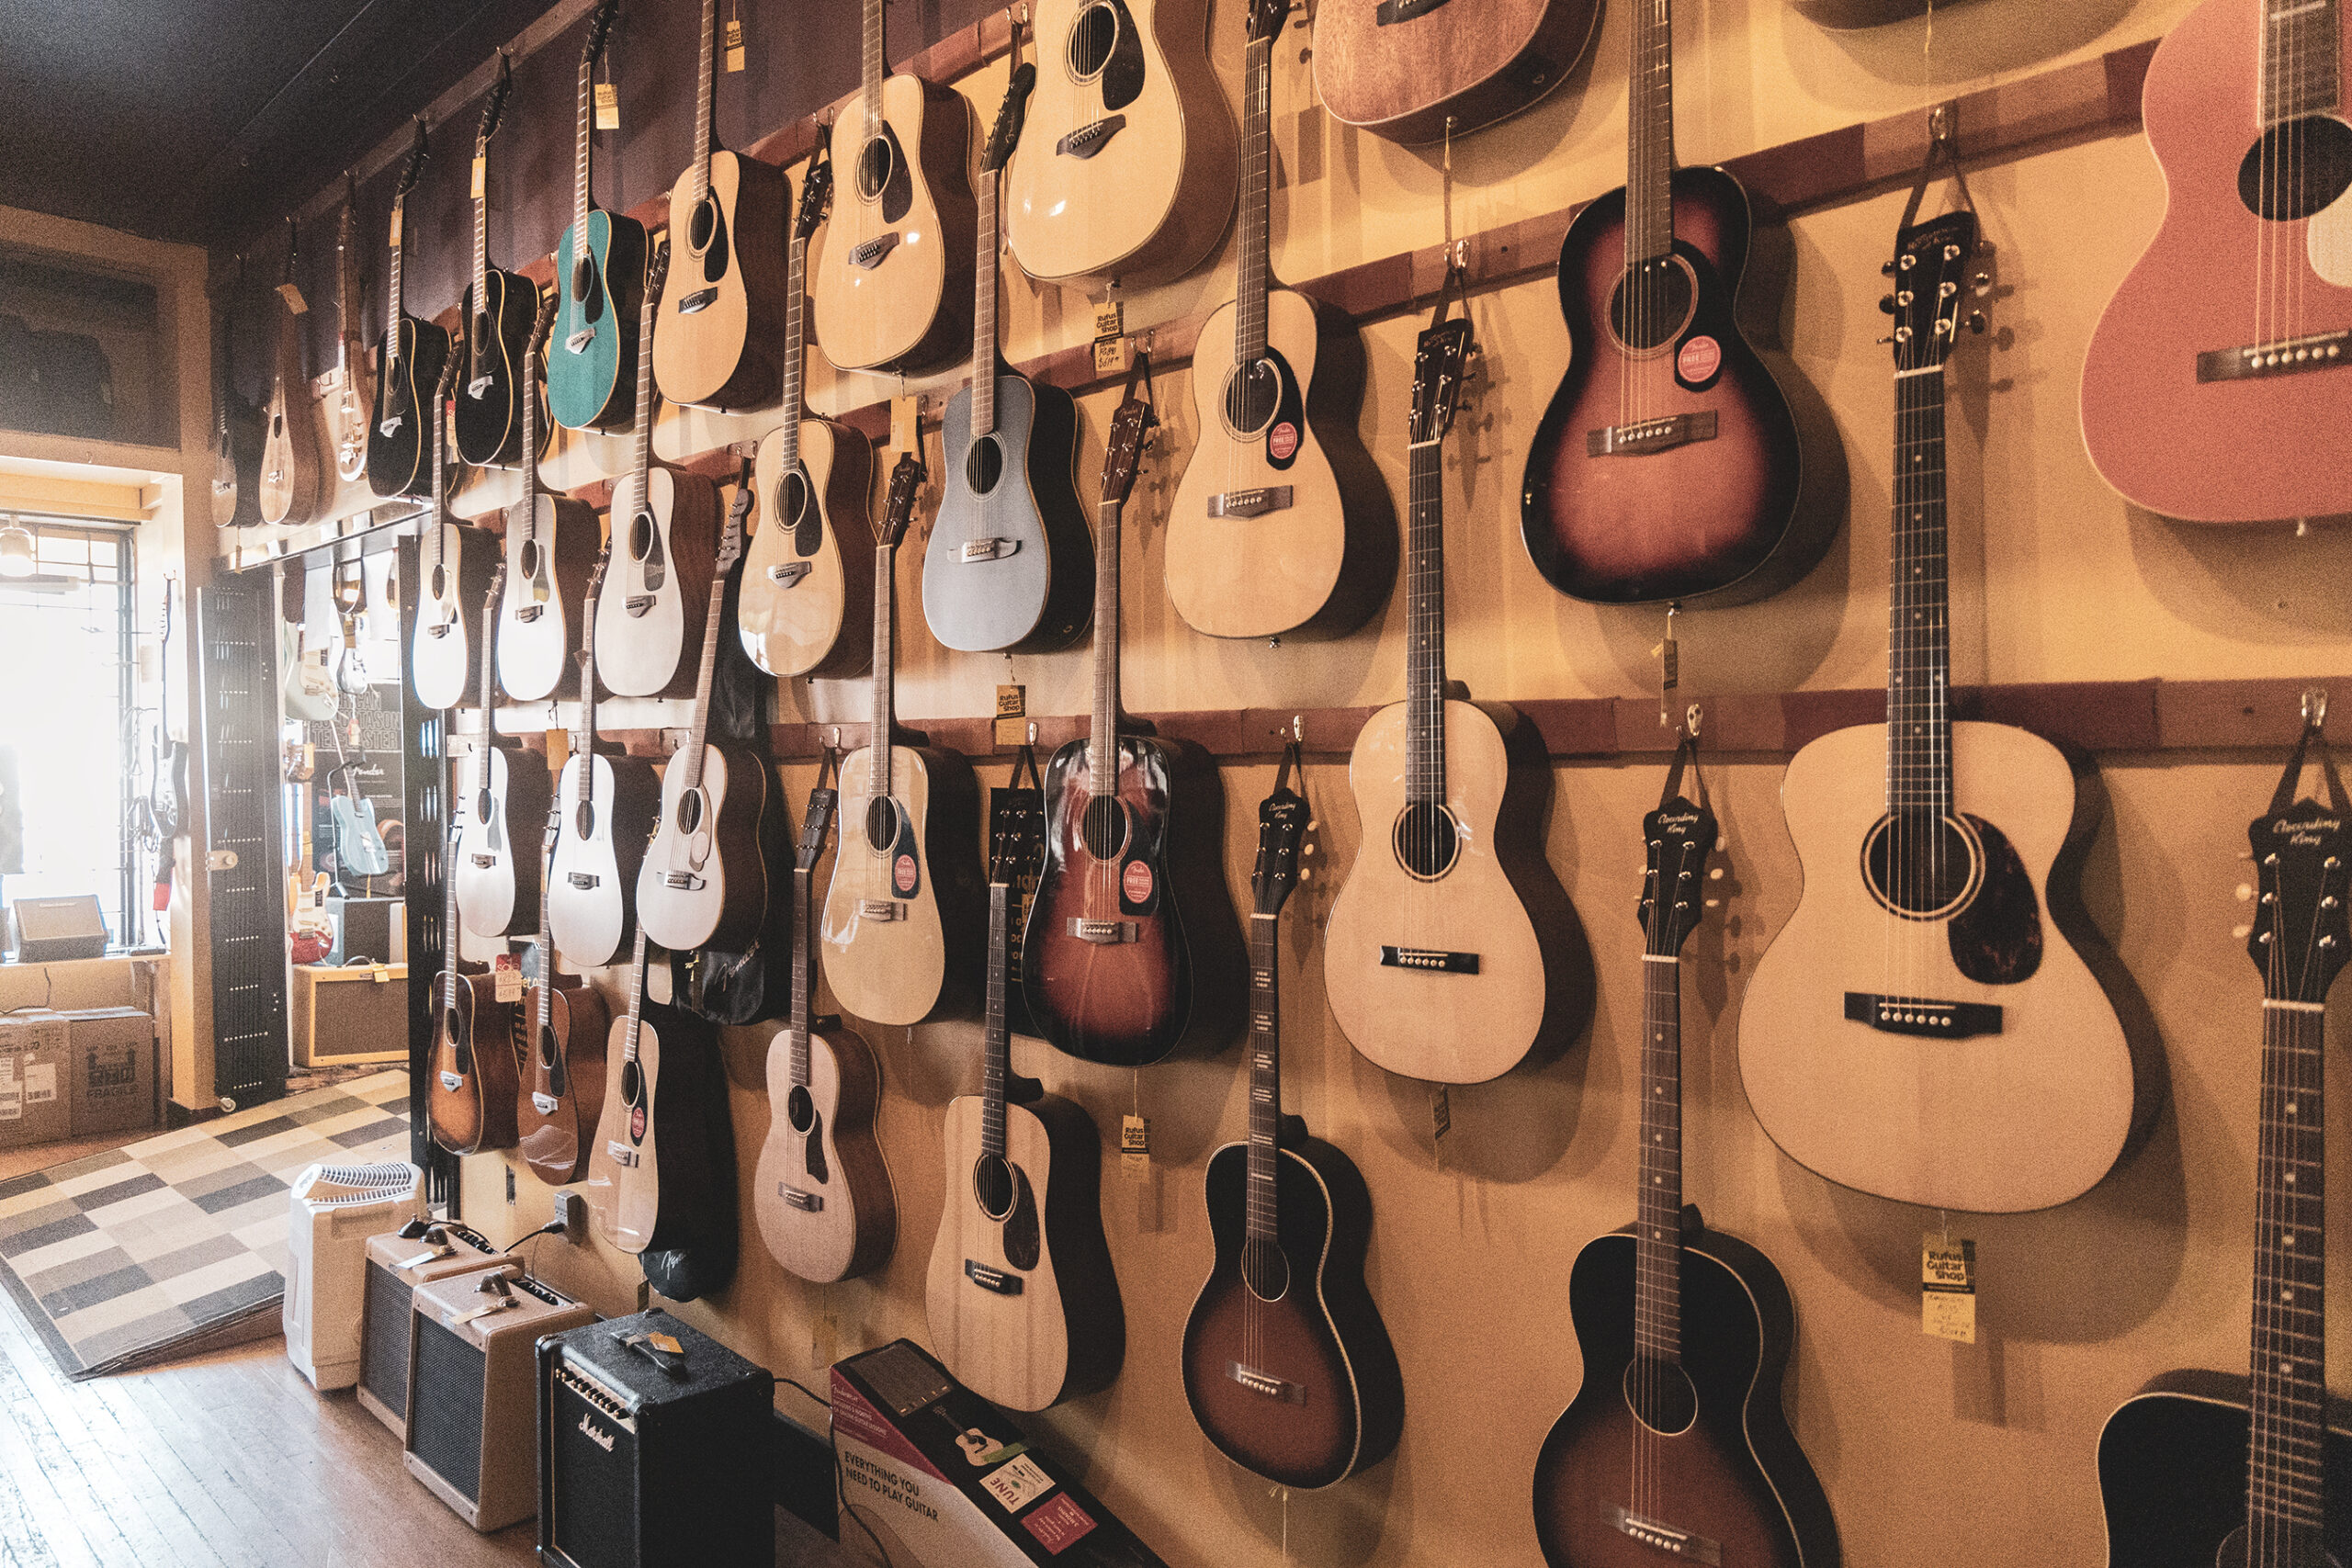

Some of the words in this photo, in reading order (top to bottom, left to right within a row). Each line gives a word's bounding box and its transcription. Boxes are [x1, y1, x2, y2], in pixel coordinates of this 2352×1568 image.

[1097, 313, 1116, 321] Rufus
[1096, 319, 1116, 328] Guitar
[1667, 823, 1687, 835] King
[2290, 830, 2323, 845] King
[1928, 1251, 1962, 1261] Rufus
[1927, 1260, 1962, 1270] Guitar
[1936, 1269, 1964, 1281] Shop
[579, 1413, 615, 1452] Marshall
[844, 1451, 898, 1485] EVERYTHING
[899, 1476, 920, 1496] YOU
[846, 1468, 867, 1485] NEED
[868, 1477, 881, 1493] TO
[882, 1484, 903, 1504] PLAY
[905, 1496, 938, 1522] GUITAR
[989, 1477, 1021, 1506] TUNE
